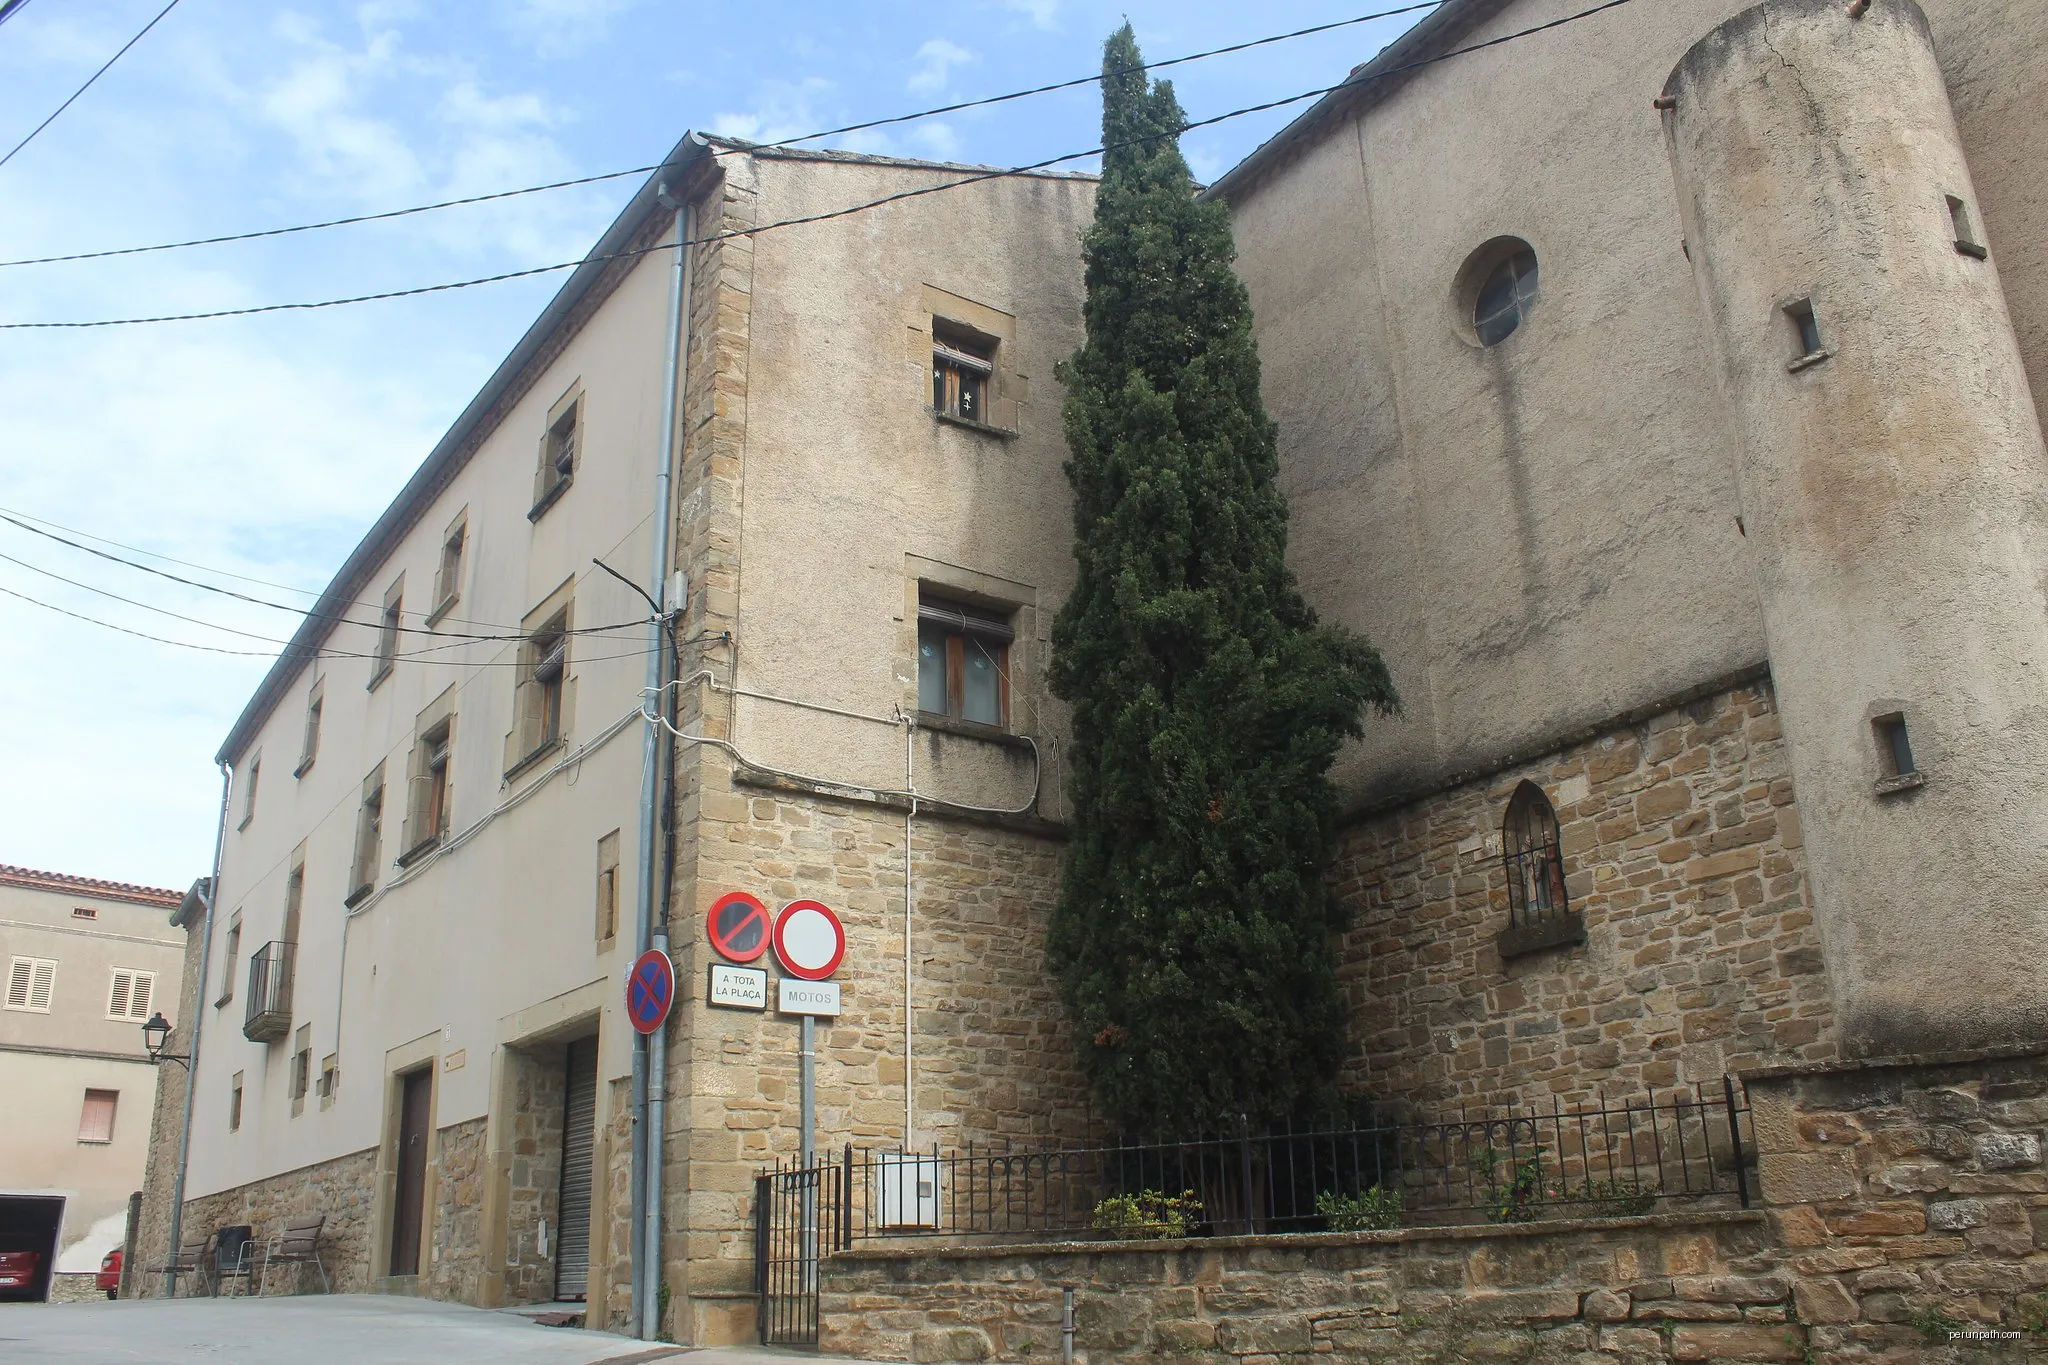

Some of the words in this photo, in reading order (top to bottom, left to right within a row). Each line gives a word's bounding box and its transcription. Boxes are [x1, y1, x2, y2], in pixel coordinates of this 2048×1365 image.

[722, 974, 729, 983] A
[733, 975, 755, 985] TOTA
[715, 986, 728, 996] LA
[731, 987, 761, 1000] PLAÇA
[788, 990, 832, 1004] MOTOS
